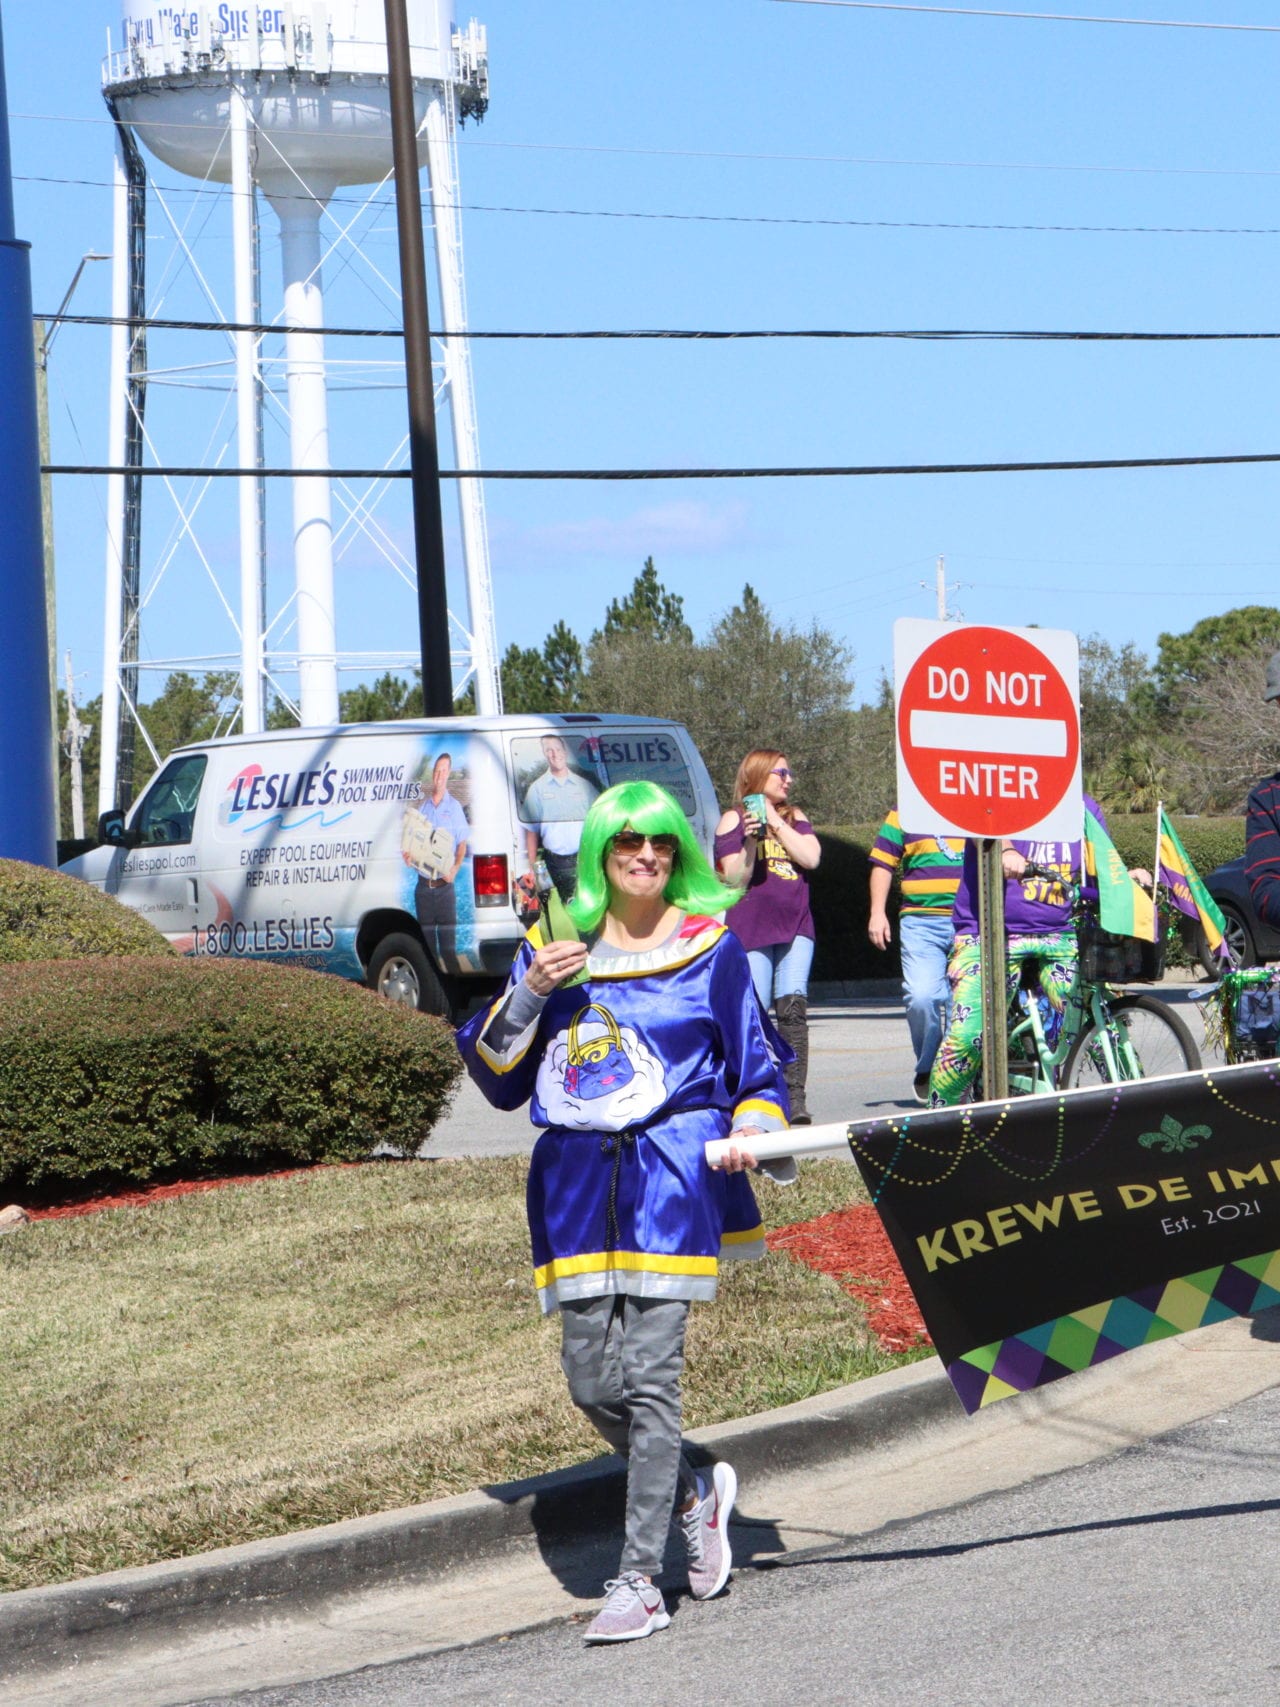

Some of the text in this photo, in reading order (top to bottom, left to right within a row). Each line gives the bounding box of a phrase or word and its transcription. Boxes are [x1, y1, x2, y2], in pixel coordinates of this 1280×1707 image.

[928, 665, 1046, 707] DO NOT
[586, 738, 671, 763] LESLIE'S
[231, 761, 337, 812] LESLIE'S
[342, 765, 404, 785] SWIMMING
[939, 761, 1039, 799] ENTER
[336, 782, 421, 805] POOL SUPPLIES
[240, 841, 373, 866] EXPERT POOL EQUIPMENT
[1061, 842, 1072, 863] A
[246, 864, 366, 888] REPAIR & INSTALLATION
[916, 1190, 1102, 1272] KREWE
[1117, 1176, 1192, 1210] DE
[1161, 1200, 1260, 1235] Est. 2021
